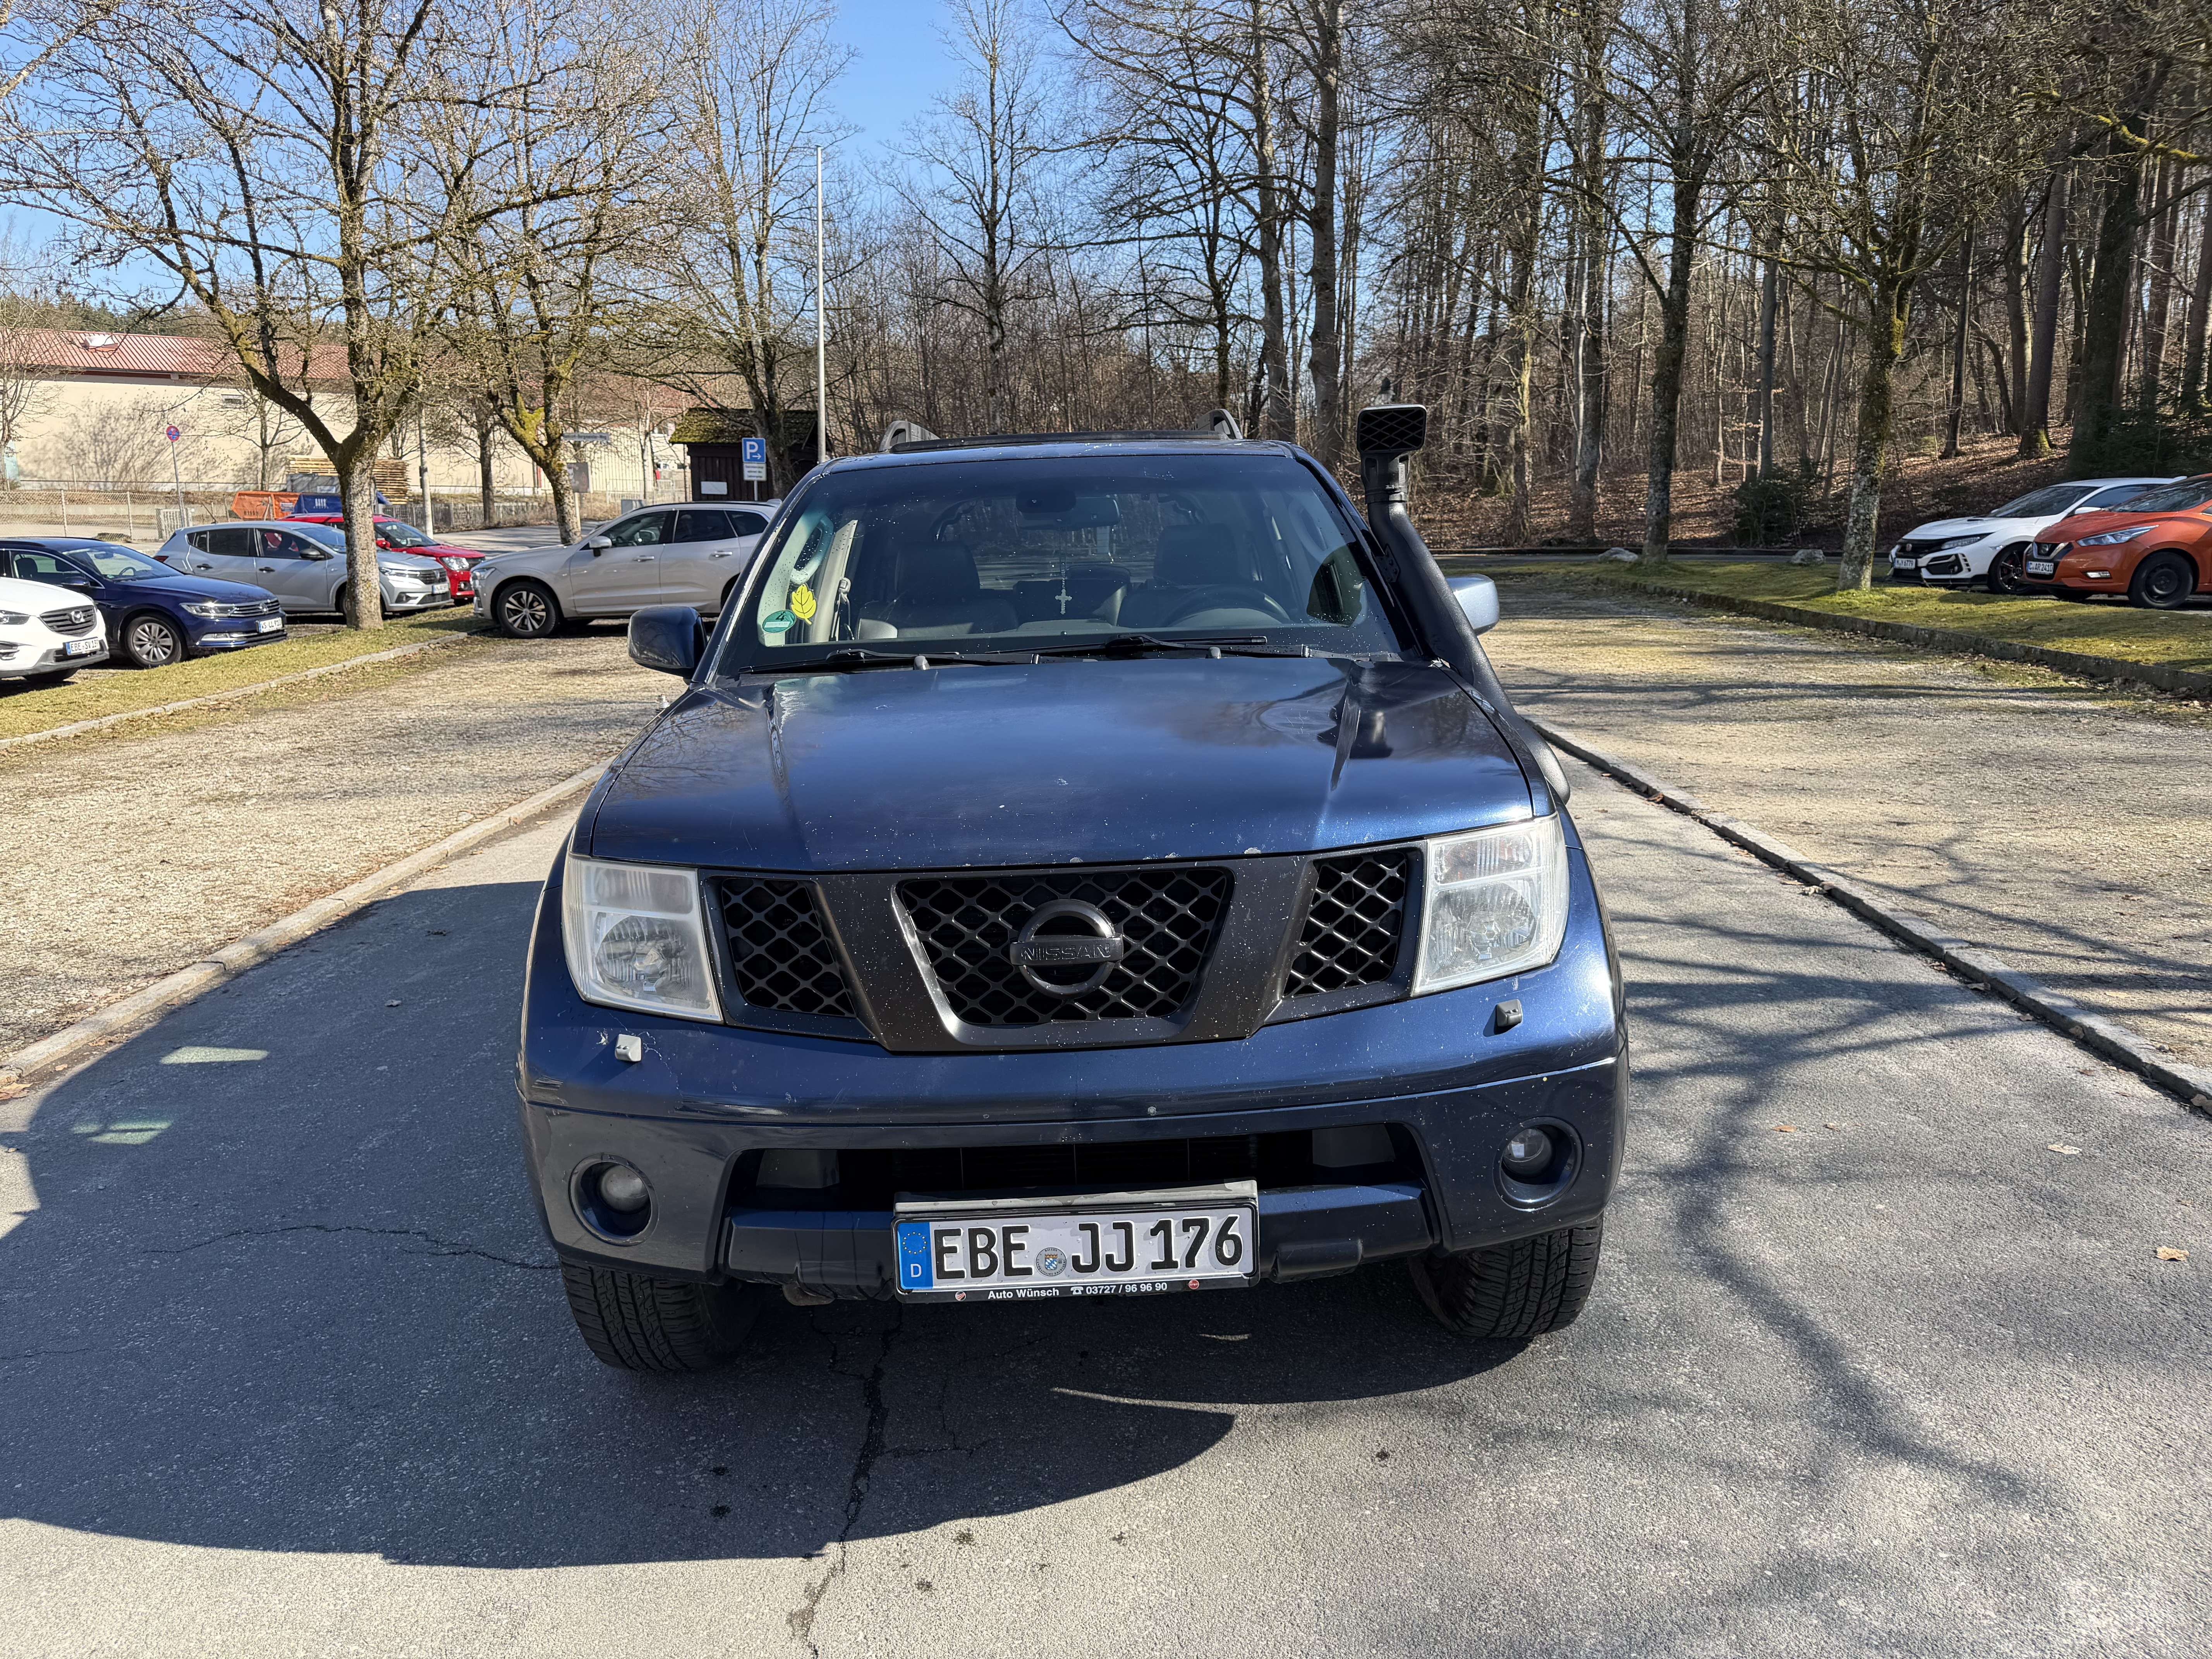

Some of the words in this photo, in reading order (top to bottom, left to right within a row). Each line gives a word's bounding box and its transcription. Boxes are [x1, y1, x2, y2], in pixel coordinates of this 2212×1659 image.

[746, 441, 759, 459] P
[775, 611, 786, 622] 4
[70, 642, 82, 651] EBE
[1021, 943, 1111, 961] NISSAN
[934, 1225, 1033, 1279] EBE
[1072, 1221, 1134, 1273] JJ
[1150, 1216, 1243, 1270] 176
[910, 1264, 922, 1278] D
[988, 1290, 1013, 1299] Auto
[1016, 1288, 1059, 1297] Wünsch
[1086, 1285, 1116, 1295] 03727
[1118, 1285, 1123, 1293] /
[1125, 1284, 1137, 1293] 96
[1140, 1283, 1152, 1291] 96
[1155, 1282, 1168, 1291] 90
